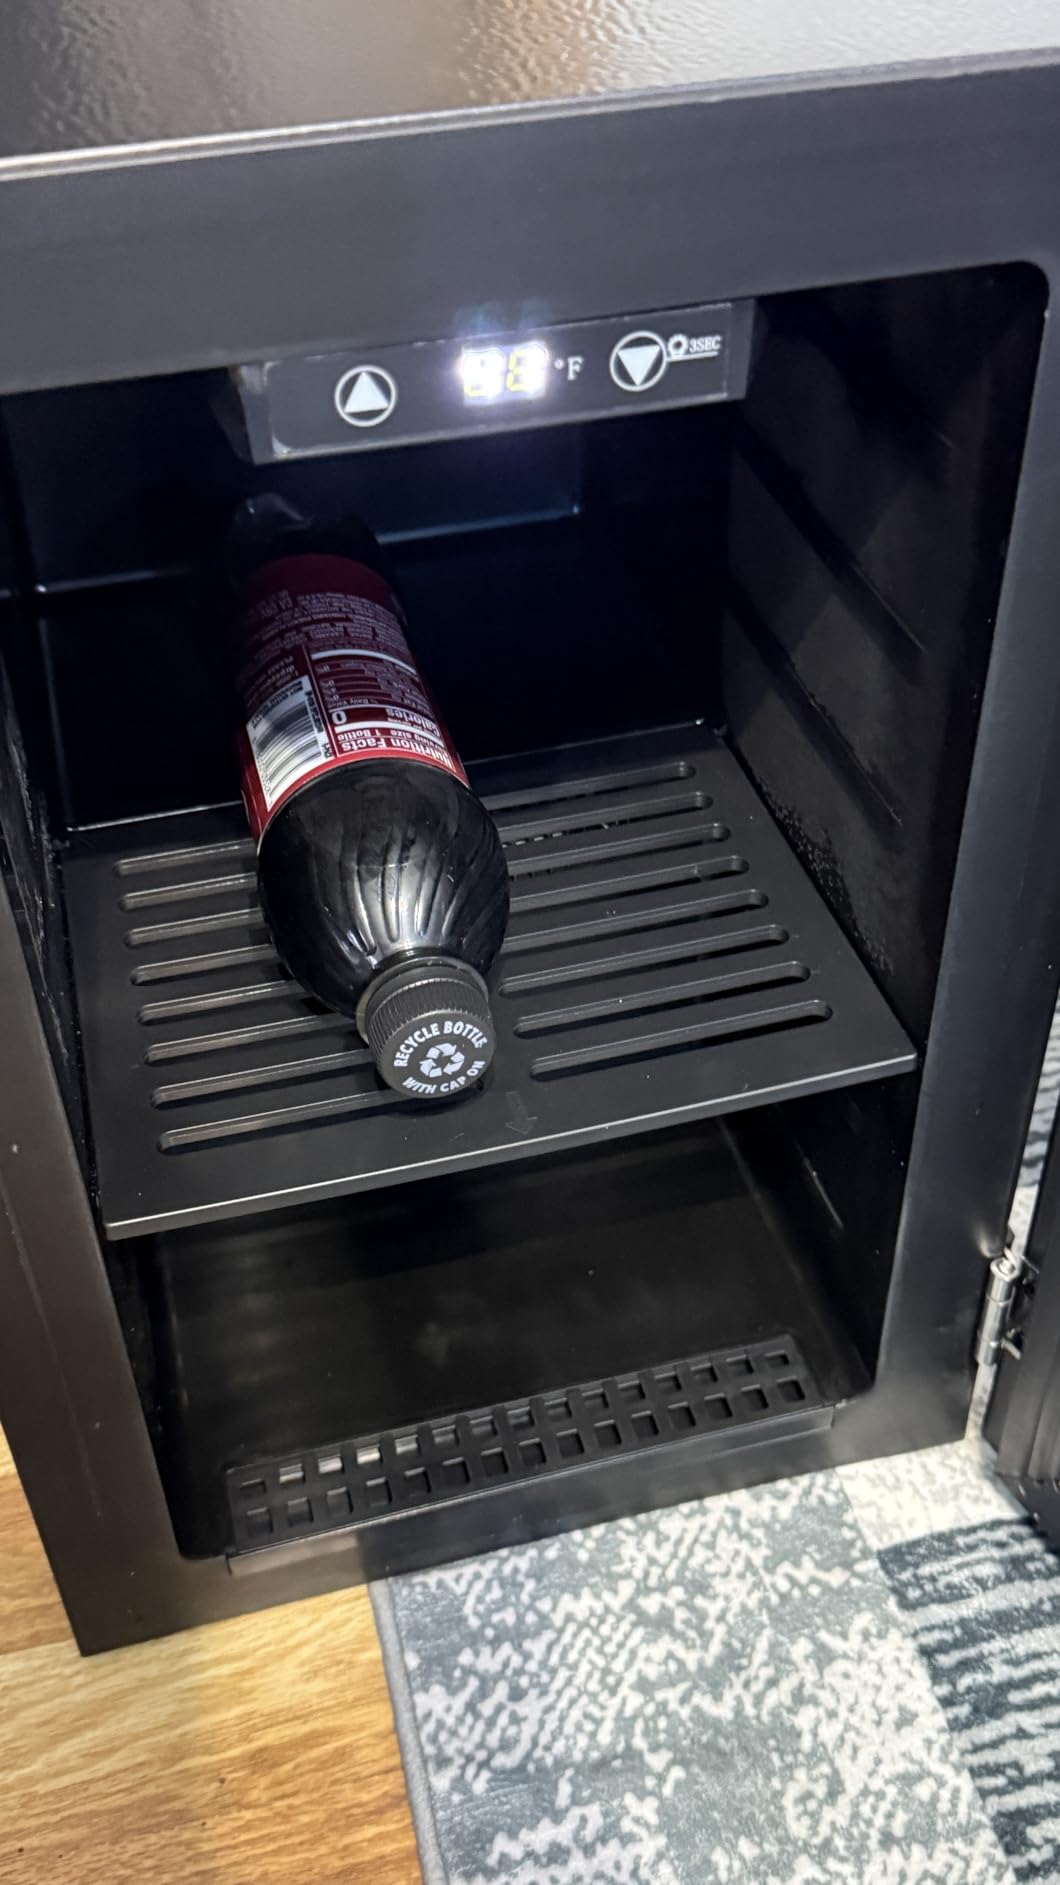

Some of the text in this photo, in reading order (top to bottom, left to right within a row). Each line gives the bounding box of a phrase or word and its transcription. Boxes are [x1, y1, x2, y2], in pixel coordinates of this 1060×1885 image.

[689, 335, 721, 353] 3SEC
[332, 711, 348, 725] 0
[386, 708, 441, 737] Calories
[337, 728, 371, 742] Bottle
[374, 728, 382, 737] 1
[391, 729, 413, 740] size
[341, 737, 387, 752] Facts
[393, 1021, 488, 1067] RECYCLE BOTTLE
[402, 1060, 485, 1094] WITH CAP ON
